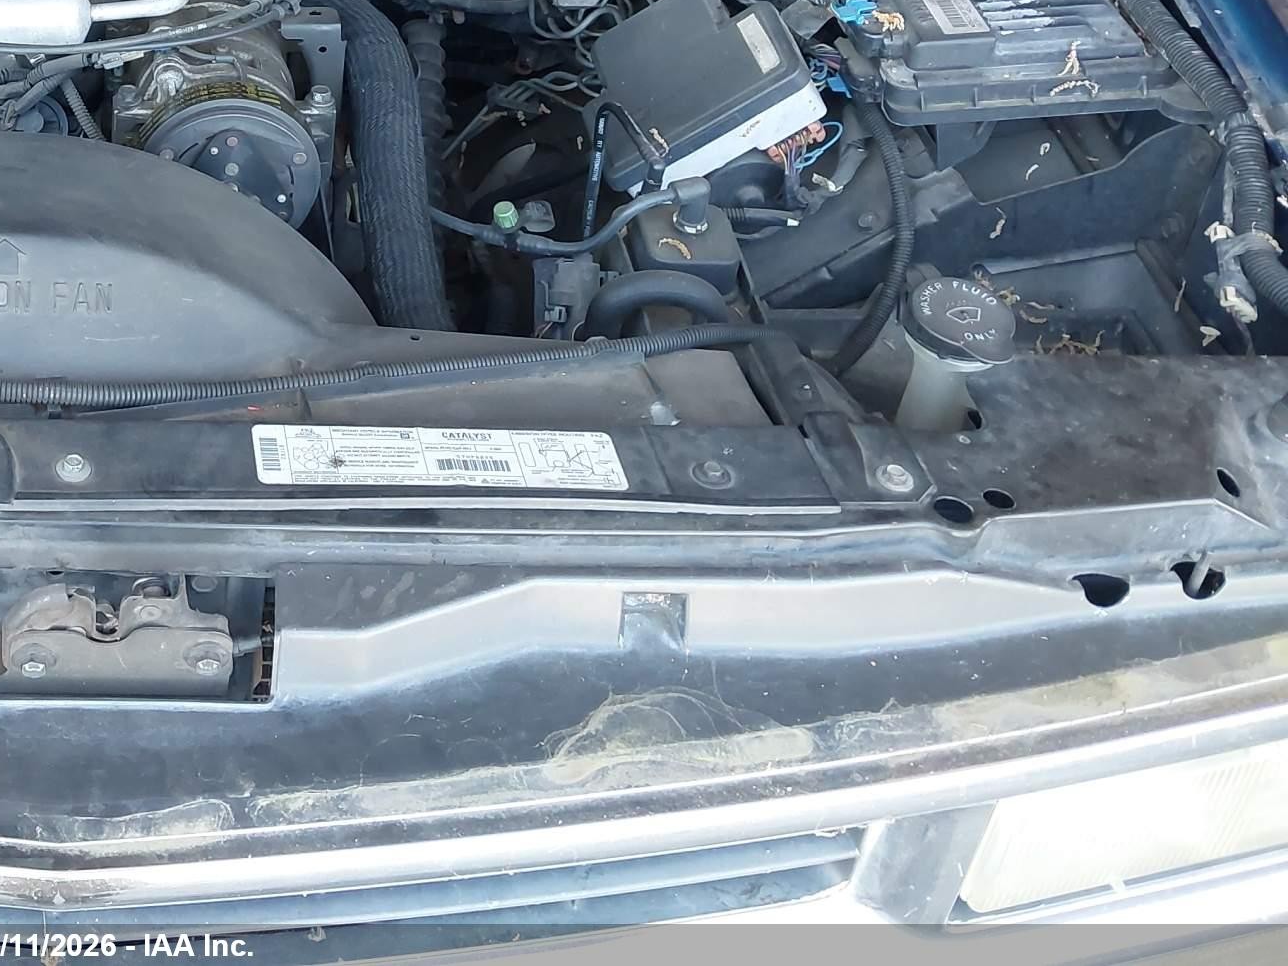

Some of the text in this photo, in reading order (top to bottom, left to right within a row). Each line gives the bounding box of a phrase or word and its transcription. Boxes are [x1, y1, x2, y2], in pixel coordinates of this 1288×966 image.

[52, 281, 113, 315] FAN
[919, 281, 998, 341] WASHER FLUID ONLY
[441, 431, 493, 440] CATALYST
